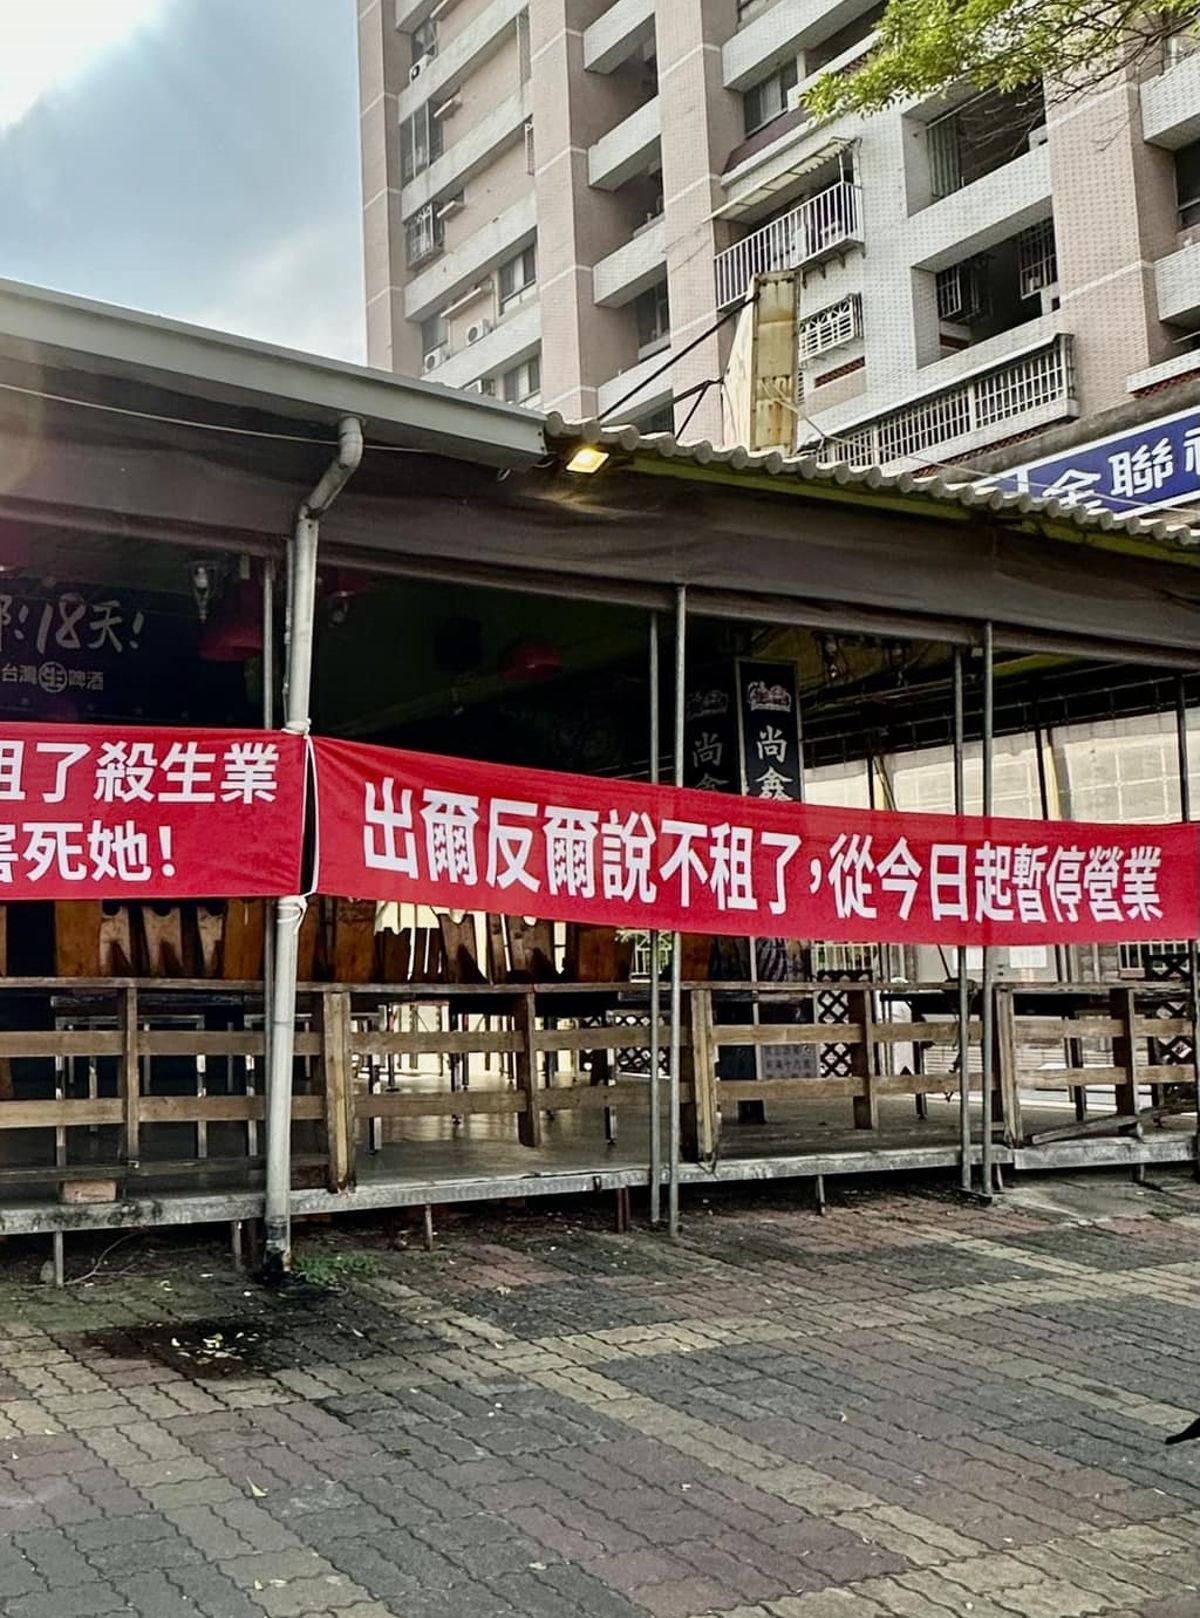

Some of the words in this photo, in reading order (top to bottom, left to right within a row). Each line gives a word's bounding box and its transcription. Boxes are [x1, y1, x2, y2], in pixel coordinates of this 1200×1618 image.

[363, 777, 1163, 923] 出爾反爾說不租了，從今日起暫停營業
